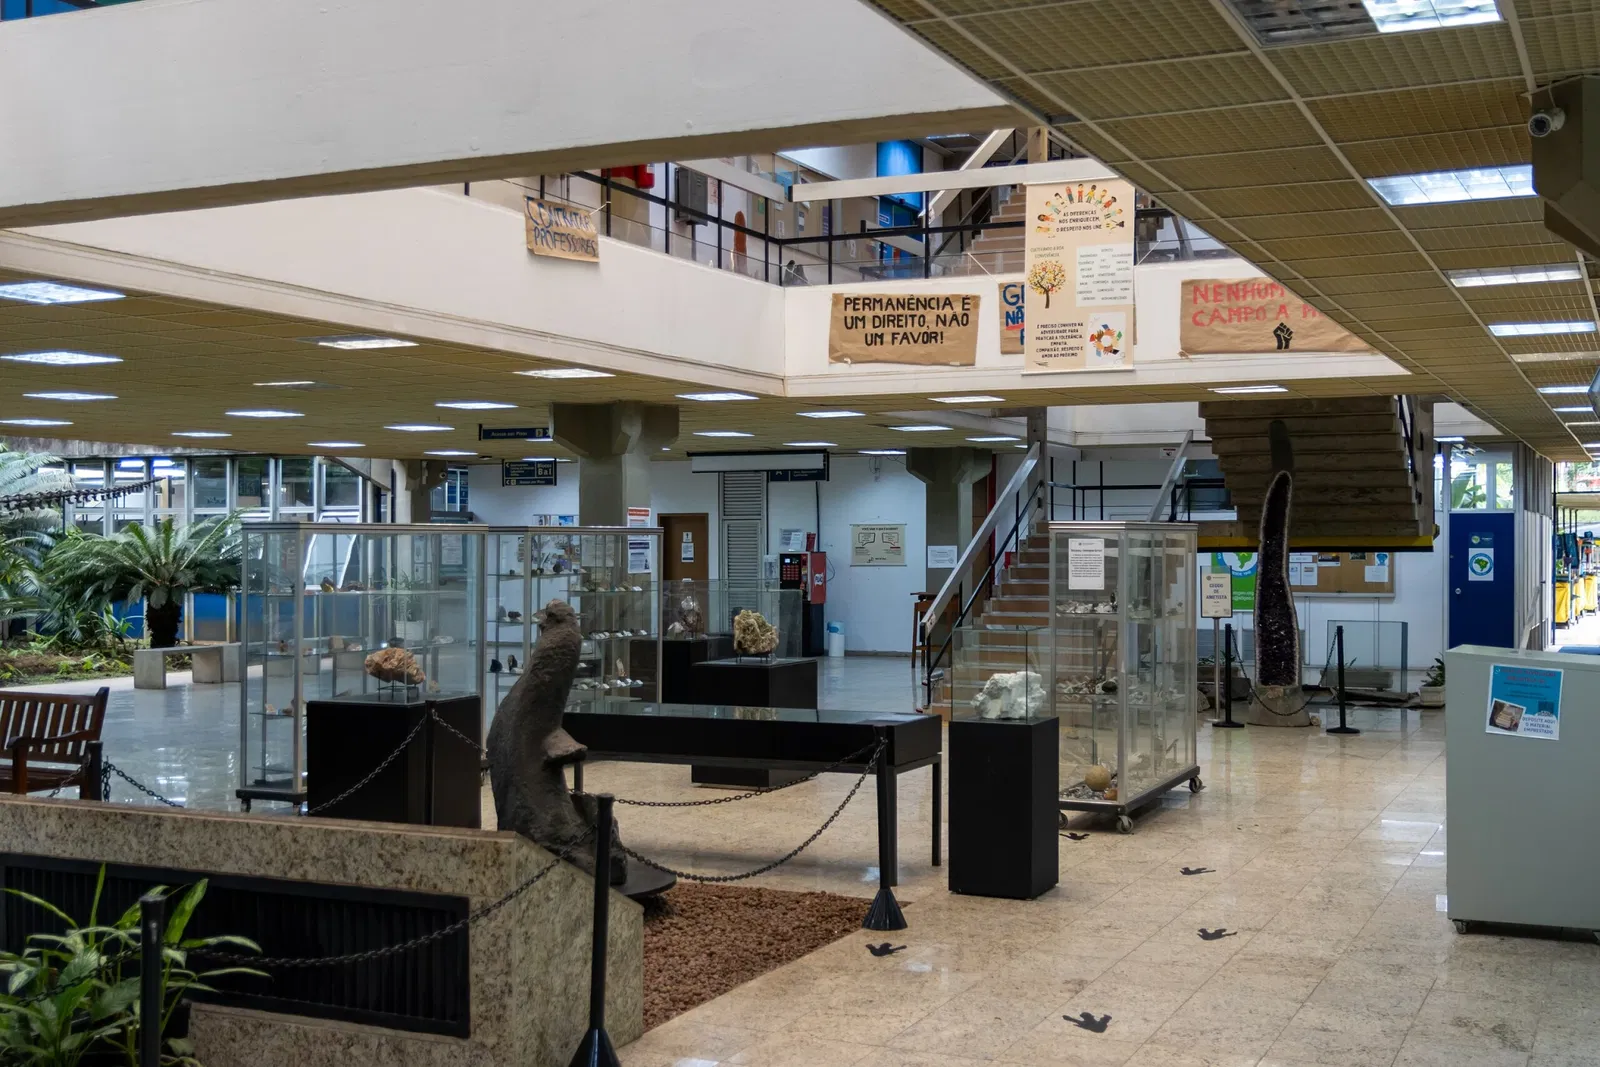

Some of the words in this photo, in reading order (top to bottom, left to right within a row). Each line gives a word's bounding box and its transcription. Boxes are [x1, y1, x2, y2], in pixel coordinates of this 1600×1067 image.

[534, 226, 596, 257] PROFESSORES
[1192, 281, 1284, 304] NENHUM
[844, 294, 954, 312] PERMANÊNCIA
[962, 294, 971, 312] É
[844, 315, 866, 329] UM
[872, 314, 930, 330] DIREITO,
[936, 313, 969, 327] NÃO
[1192, 306, 1266, 327] CAMPO
[1275, 304, 1289, 320] A
[864, 332, 884, 346] UM
[892, 331, 944, 345] FAVOR!
